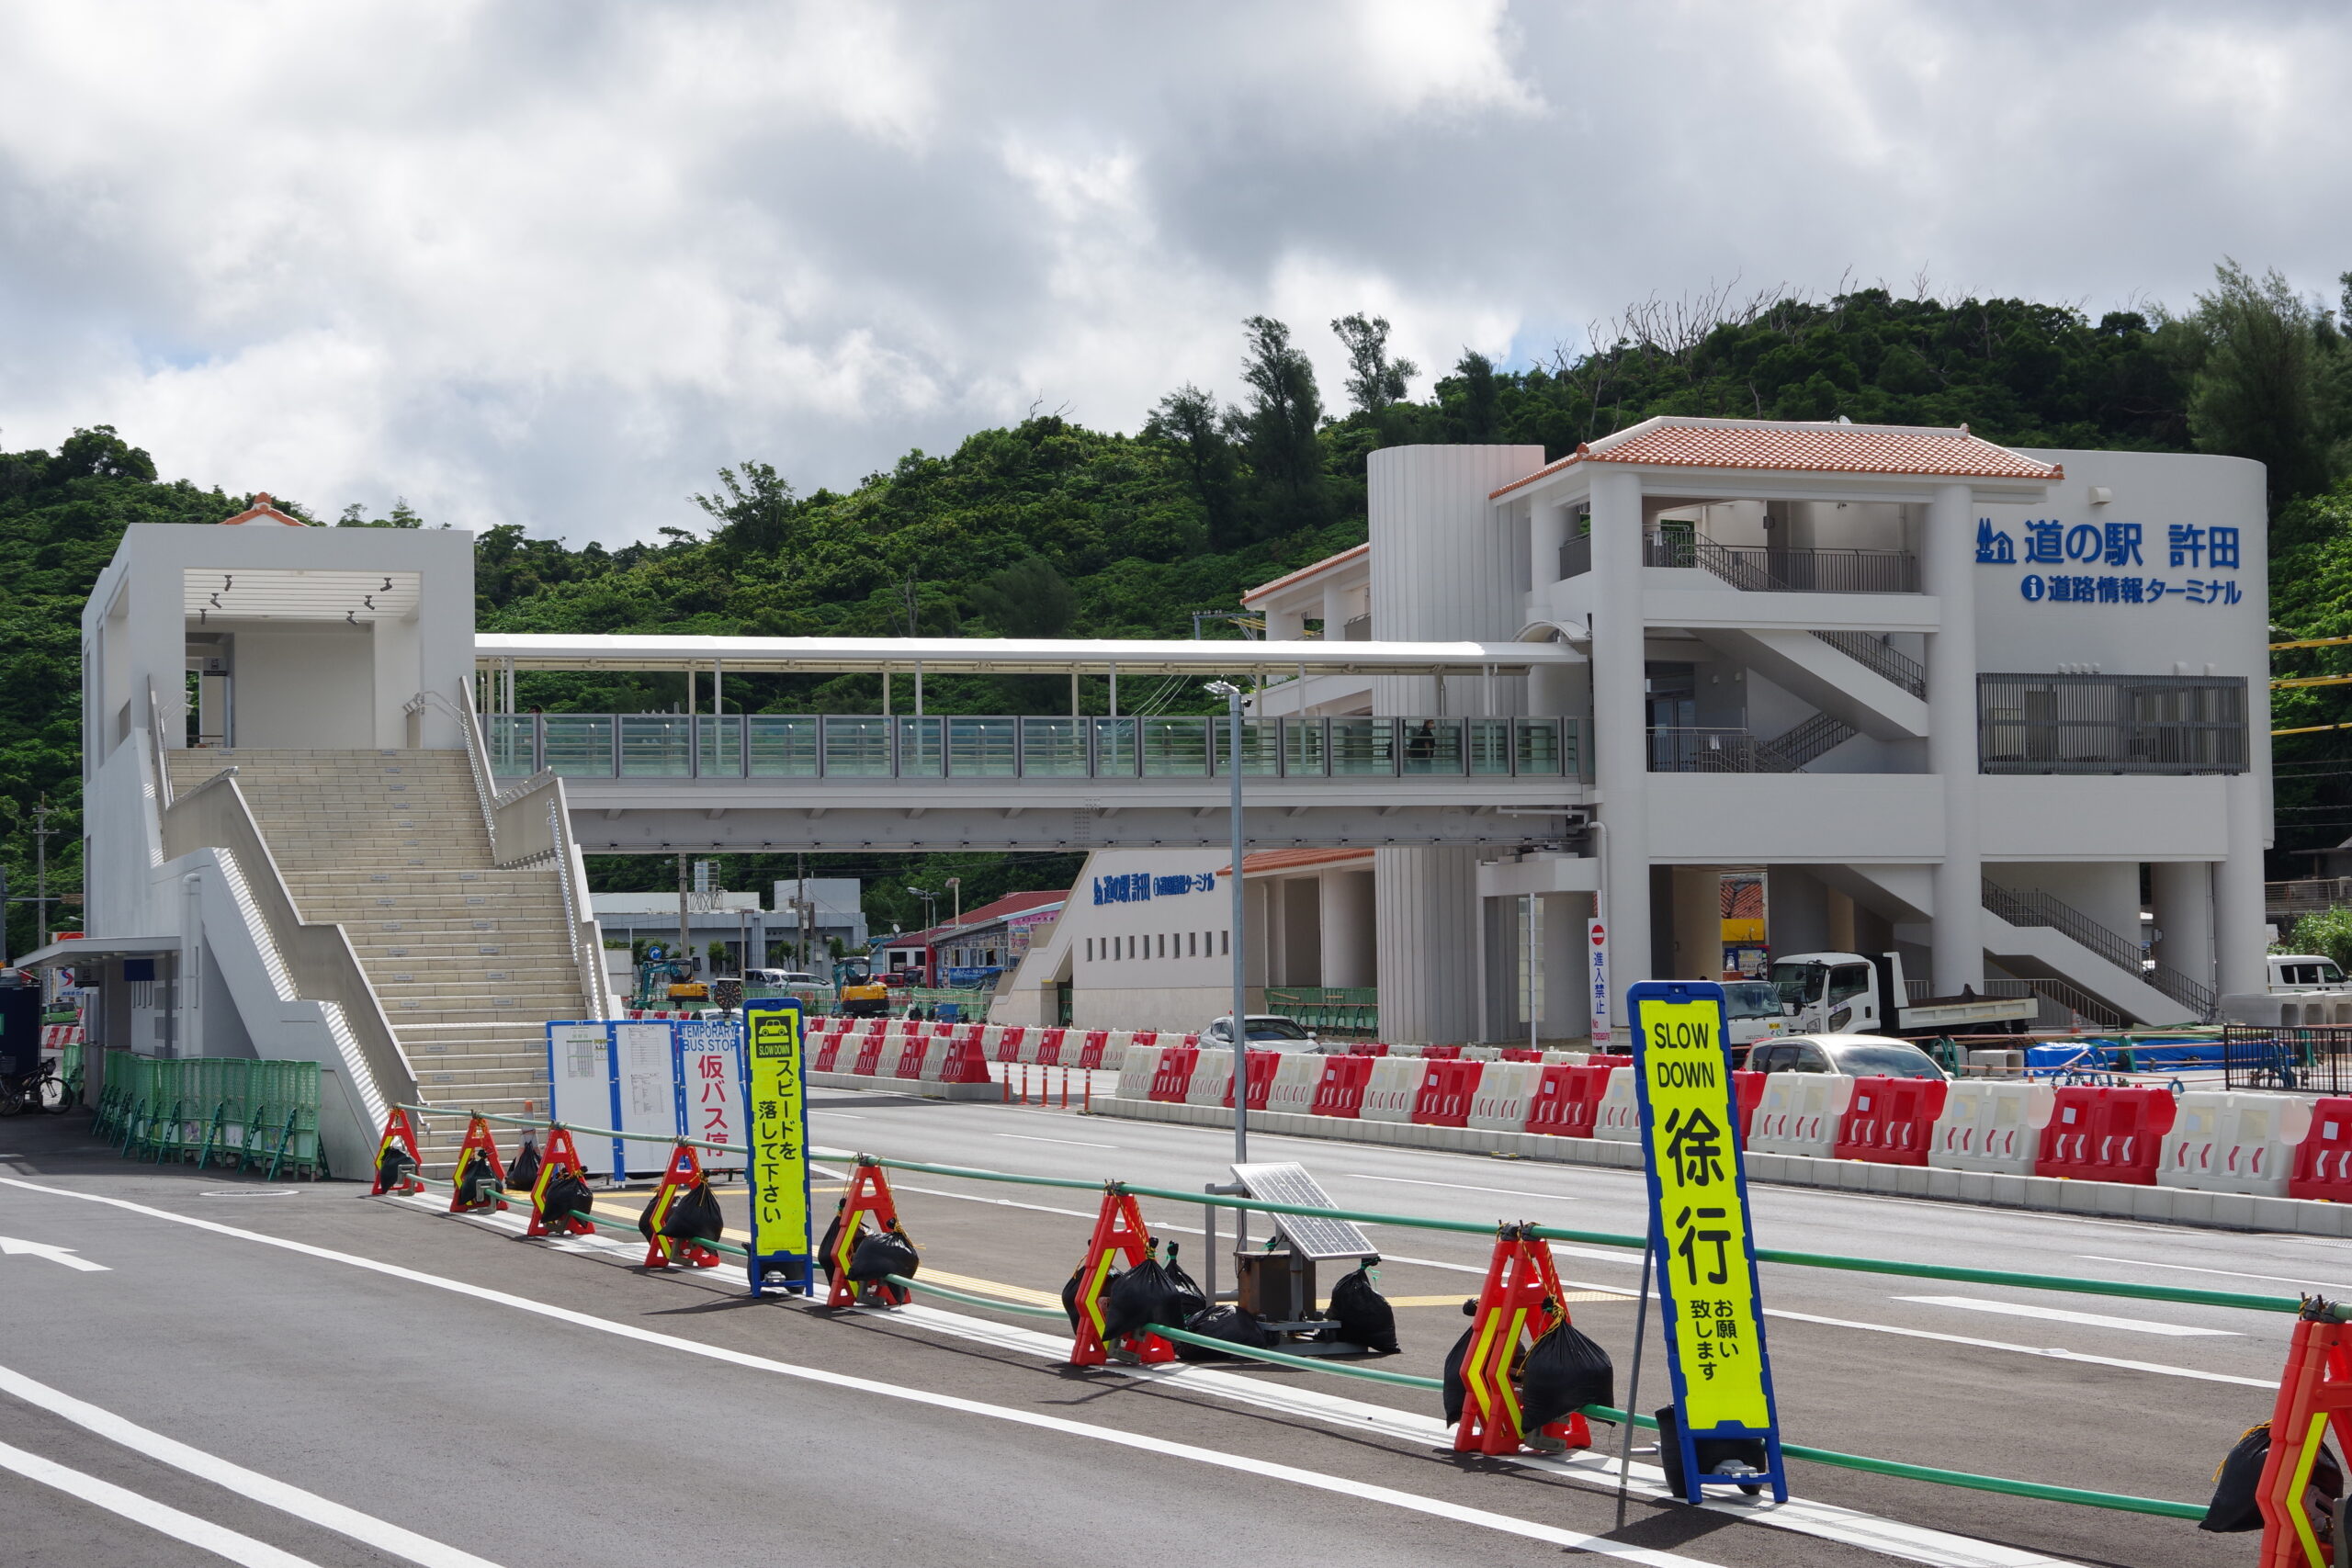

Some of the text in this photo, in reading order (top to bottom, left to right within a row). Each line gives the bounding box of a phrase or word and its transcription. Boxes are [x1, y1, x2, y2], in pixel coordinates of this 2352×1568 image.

[2024, 519, 2241, 570] 道の駅 許田
[2048, 575, 2243, 605] 道路情報ターミナル
[1159, 872, 1216, 897] ターミナル
[1593, 951, 1606, 1015] 進入禁止
[683, 1024, 736, 1038] TEMPORARY
[684, 1039, 736, 1052] BUS STOP
[759, 1044, 790, 1055] SLOW DOWN
[1655, 1022, 1709, 1049] SLOW
[1657, 1061, 1715, 1089] DOWN
[698, 1055, 729, 1157] 仮バス停
[776, 1059, 797, 1160] スピードを
[758, 1100, 782, 1224] 落して下さい
[1665, 1107, 1732, 1286] 徐行
[1690, 1299, 1718, 1382] 致します
[1714, 1299, 1739, 1359] お願い
